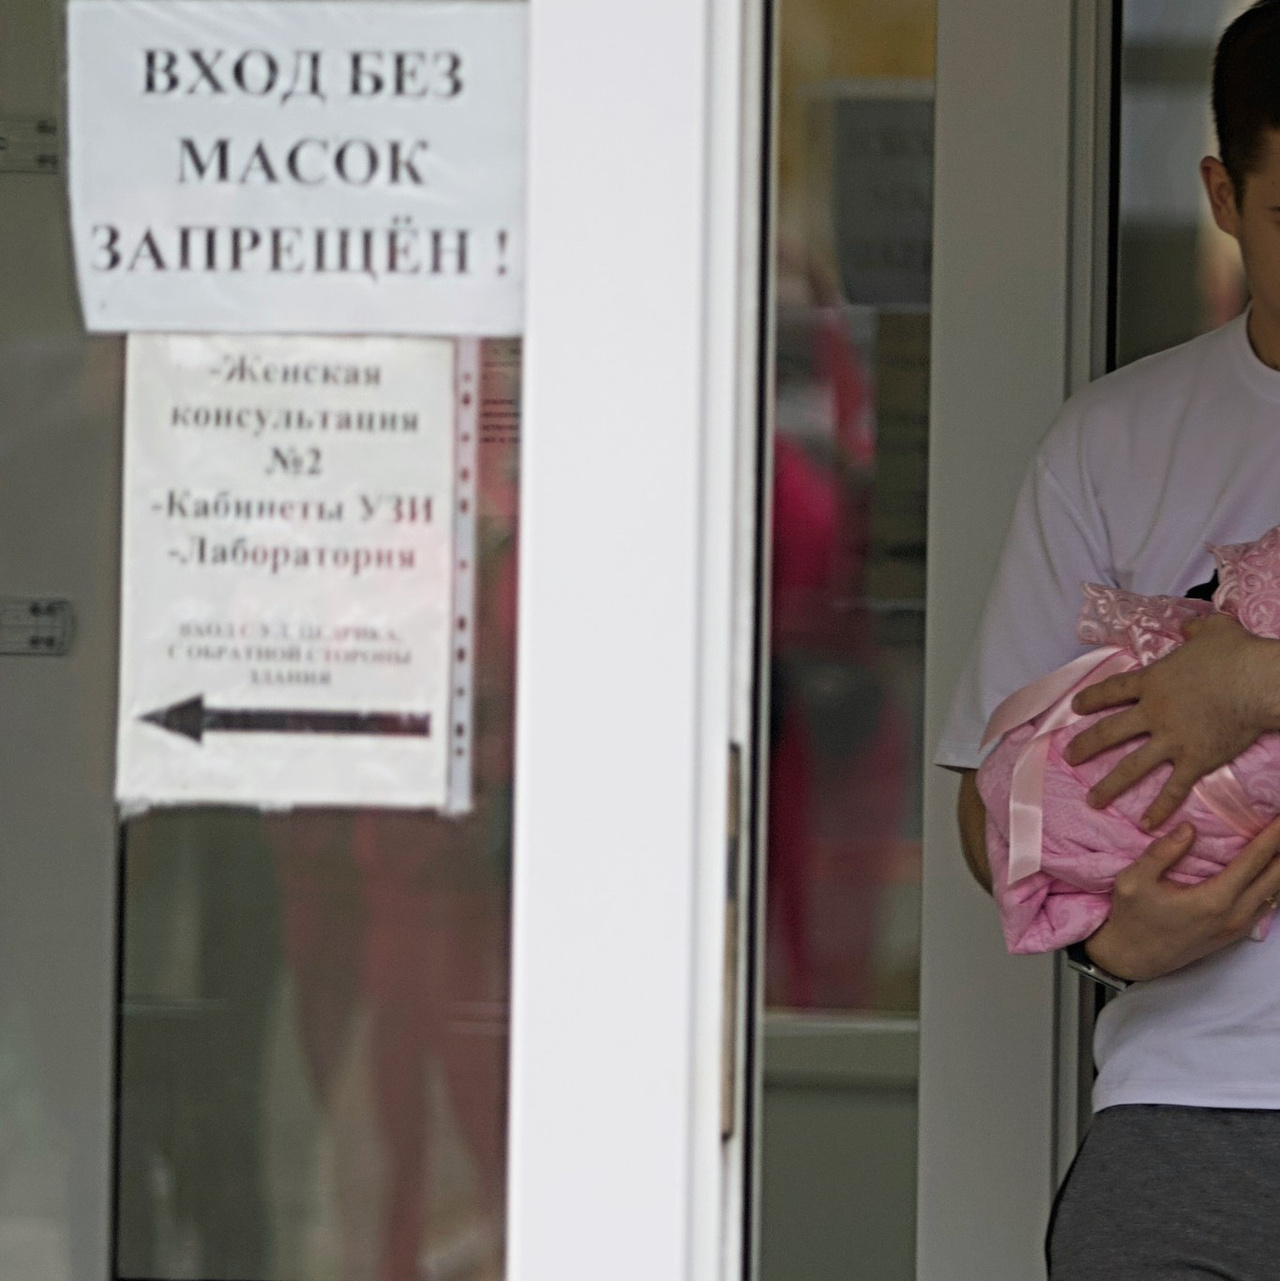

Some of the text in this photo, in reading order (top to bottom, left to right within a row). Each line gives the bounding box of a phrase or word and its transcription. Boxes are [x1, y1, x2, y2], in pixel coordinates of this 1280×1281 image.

[142, 48, 465, 105] ВХОД БЕЗ
[175, 136, 432, 187] МАСОК
[90, 215, 471, 282] ЗАПРЕЩЁН
[170, 404, 420, 434] консультация
[265, 446, 323, 477] №2
[359, 493, 434, 524] УЗИ
[168, 535, 416, 575] -Лаборатория
